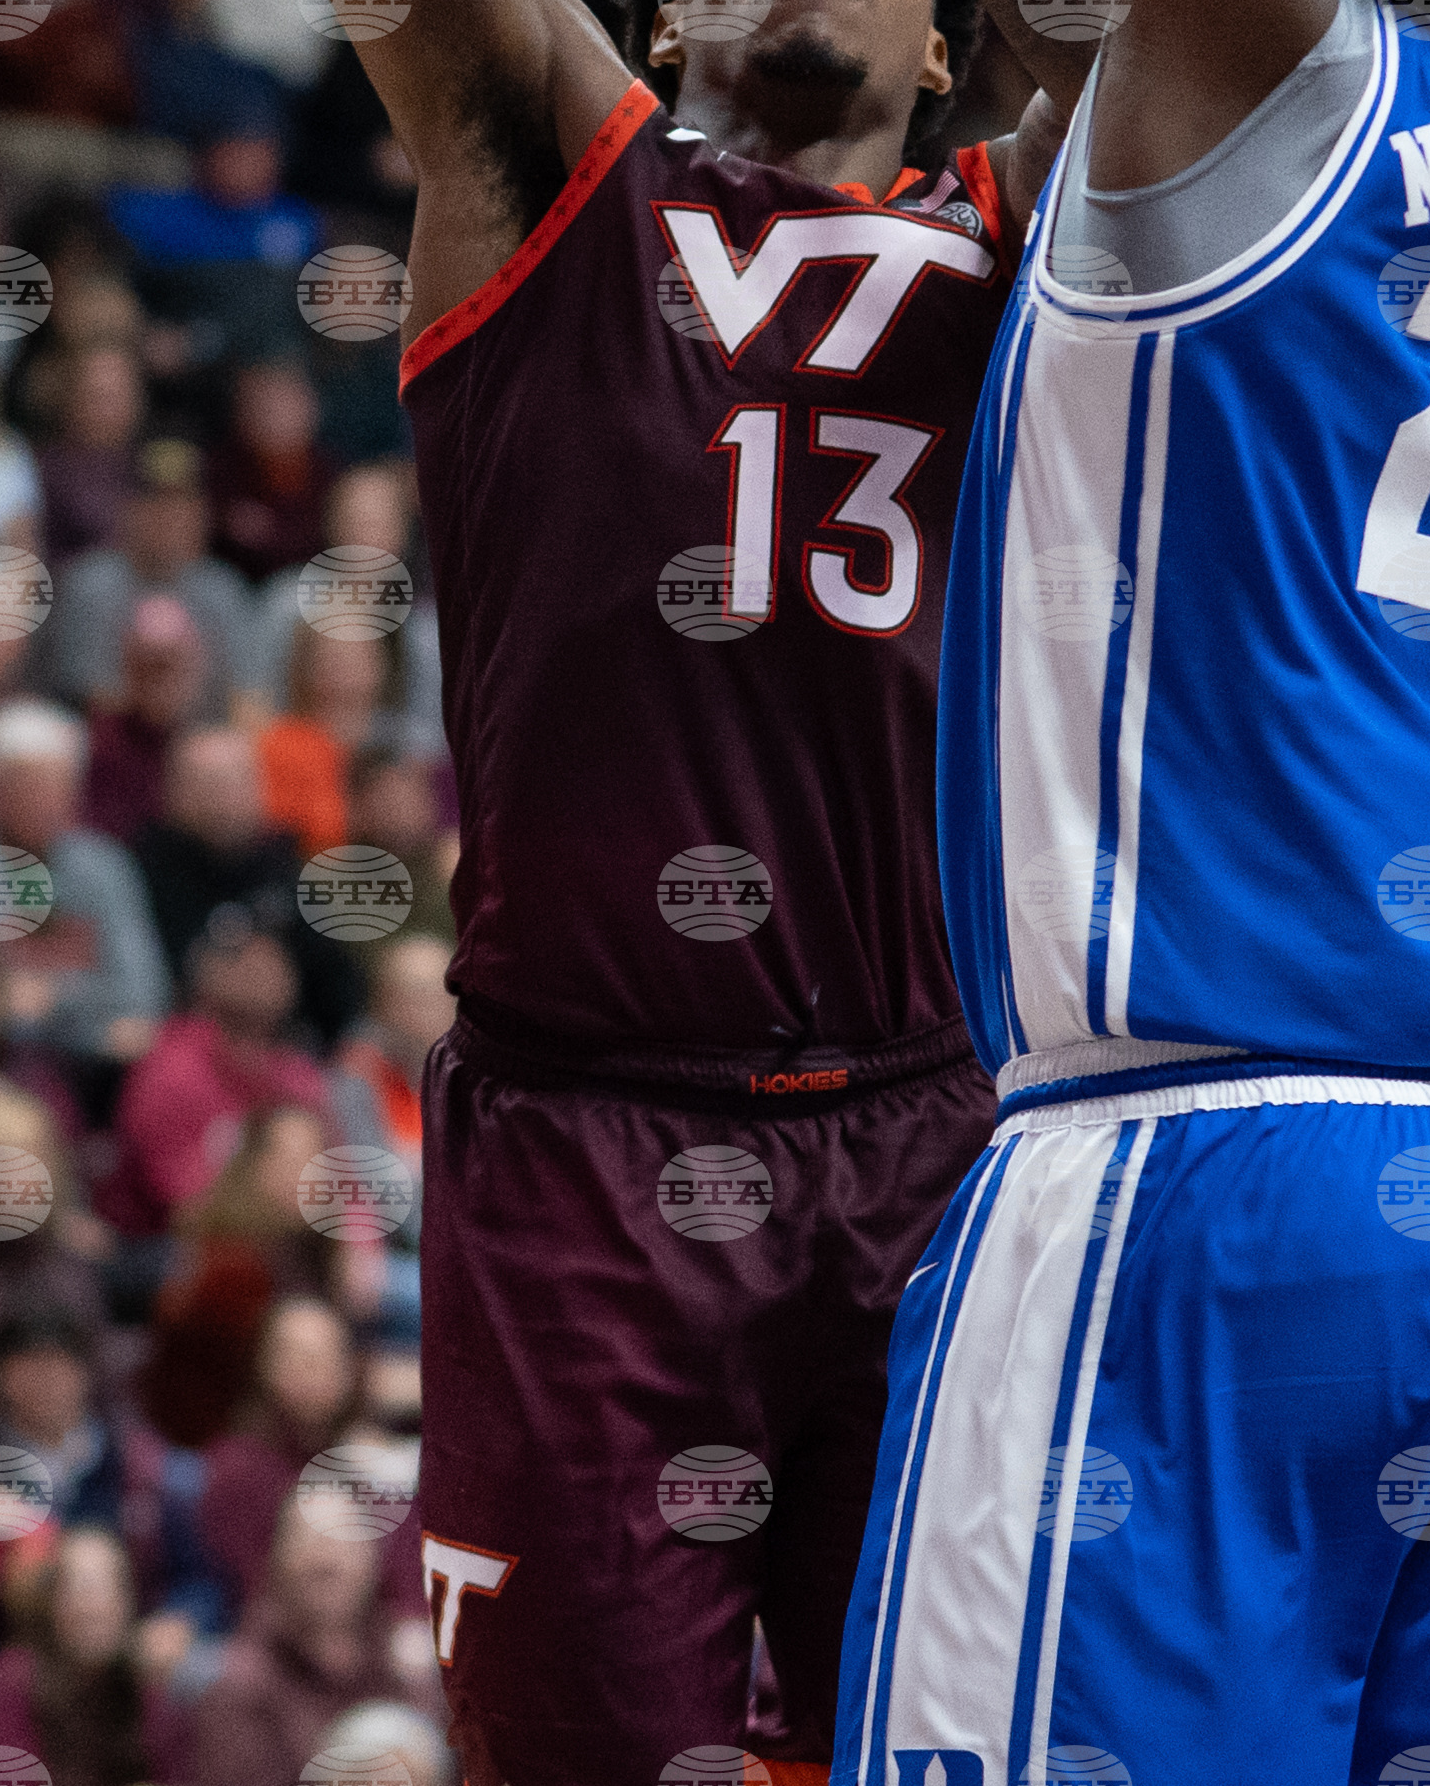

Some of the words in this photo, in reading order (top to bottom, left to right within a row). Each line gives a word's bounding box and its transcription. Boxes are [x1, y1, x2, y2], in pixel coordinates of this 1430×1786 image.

[651, 200, 998, 379] VT
[707, 403, 945, 637] 13
[749, 1068, 849, 1095] HOKIES
